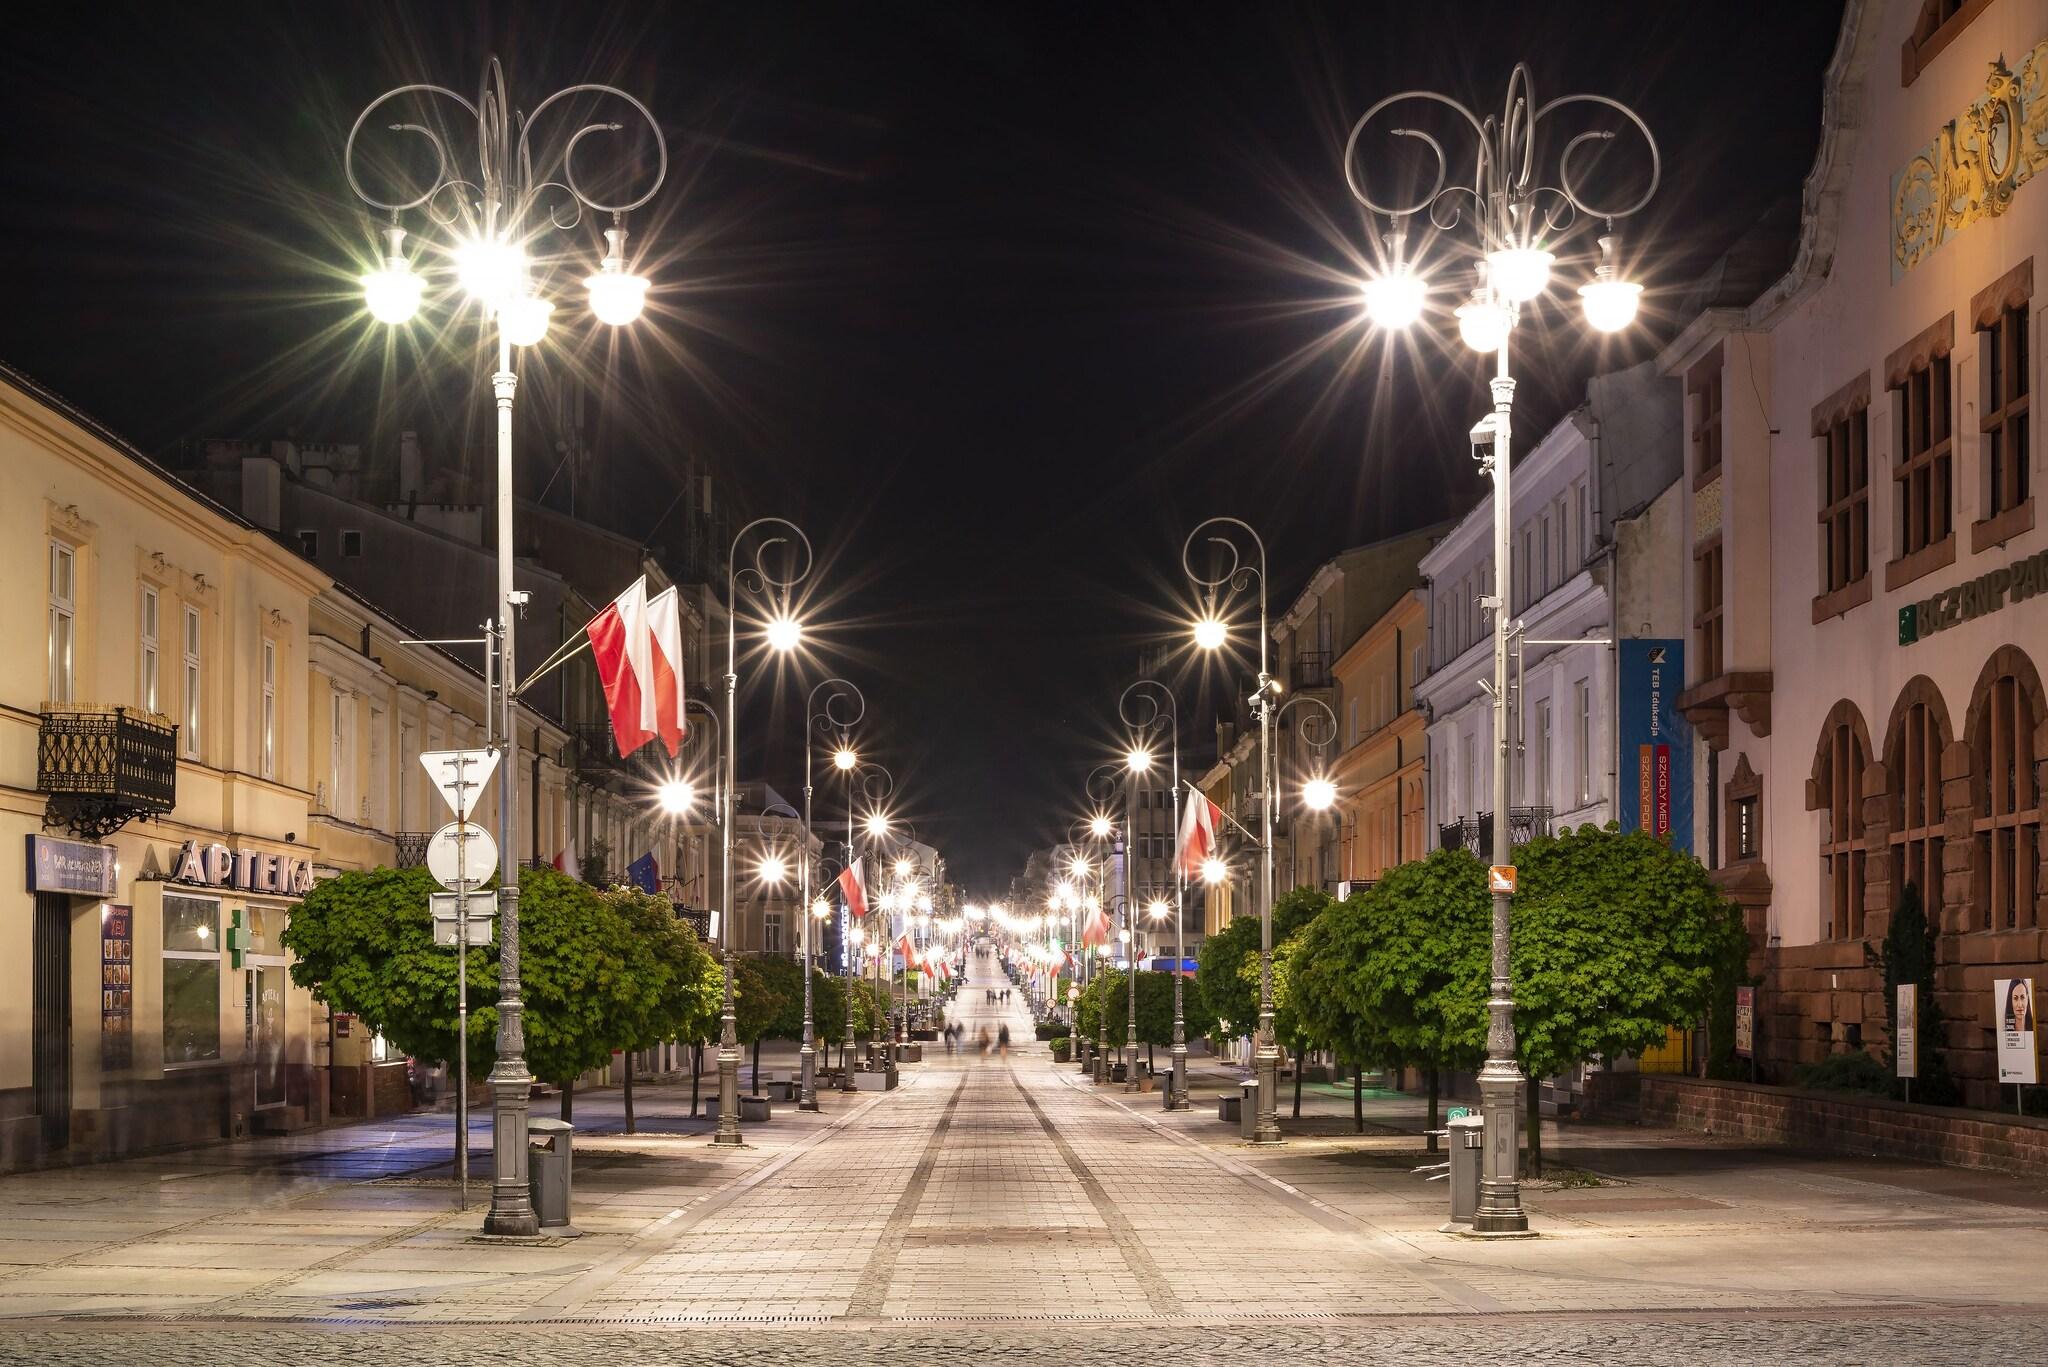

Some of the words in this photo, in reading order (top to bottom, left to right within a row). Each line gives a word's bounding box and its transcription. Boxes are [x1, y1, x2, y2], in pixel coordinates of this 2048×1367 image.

[1960, 568, 2010, 622] BNP
[1651, 668, 1660, 689] TEB
[1650, 691, 1660, 737] Edukacja
[1642, 805, 1650, 833] POLI
[171, 839, 316, 894] APTEKA
